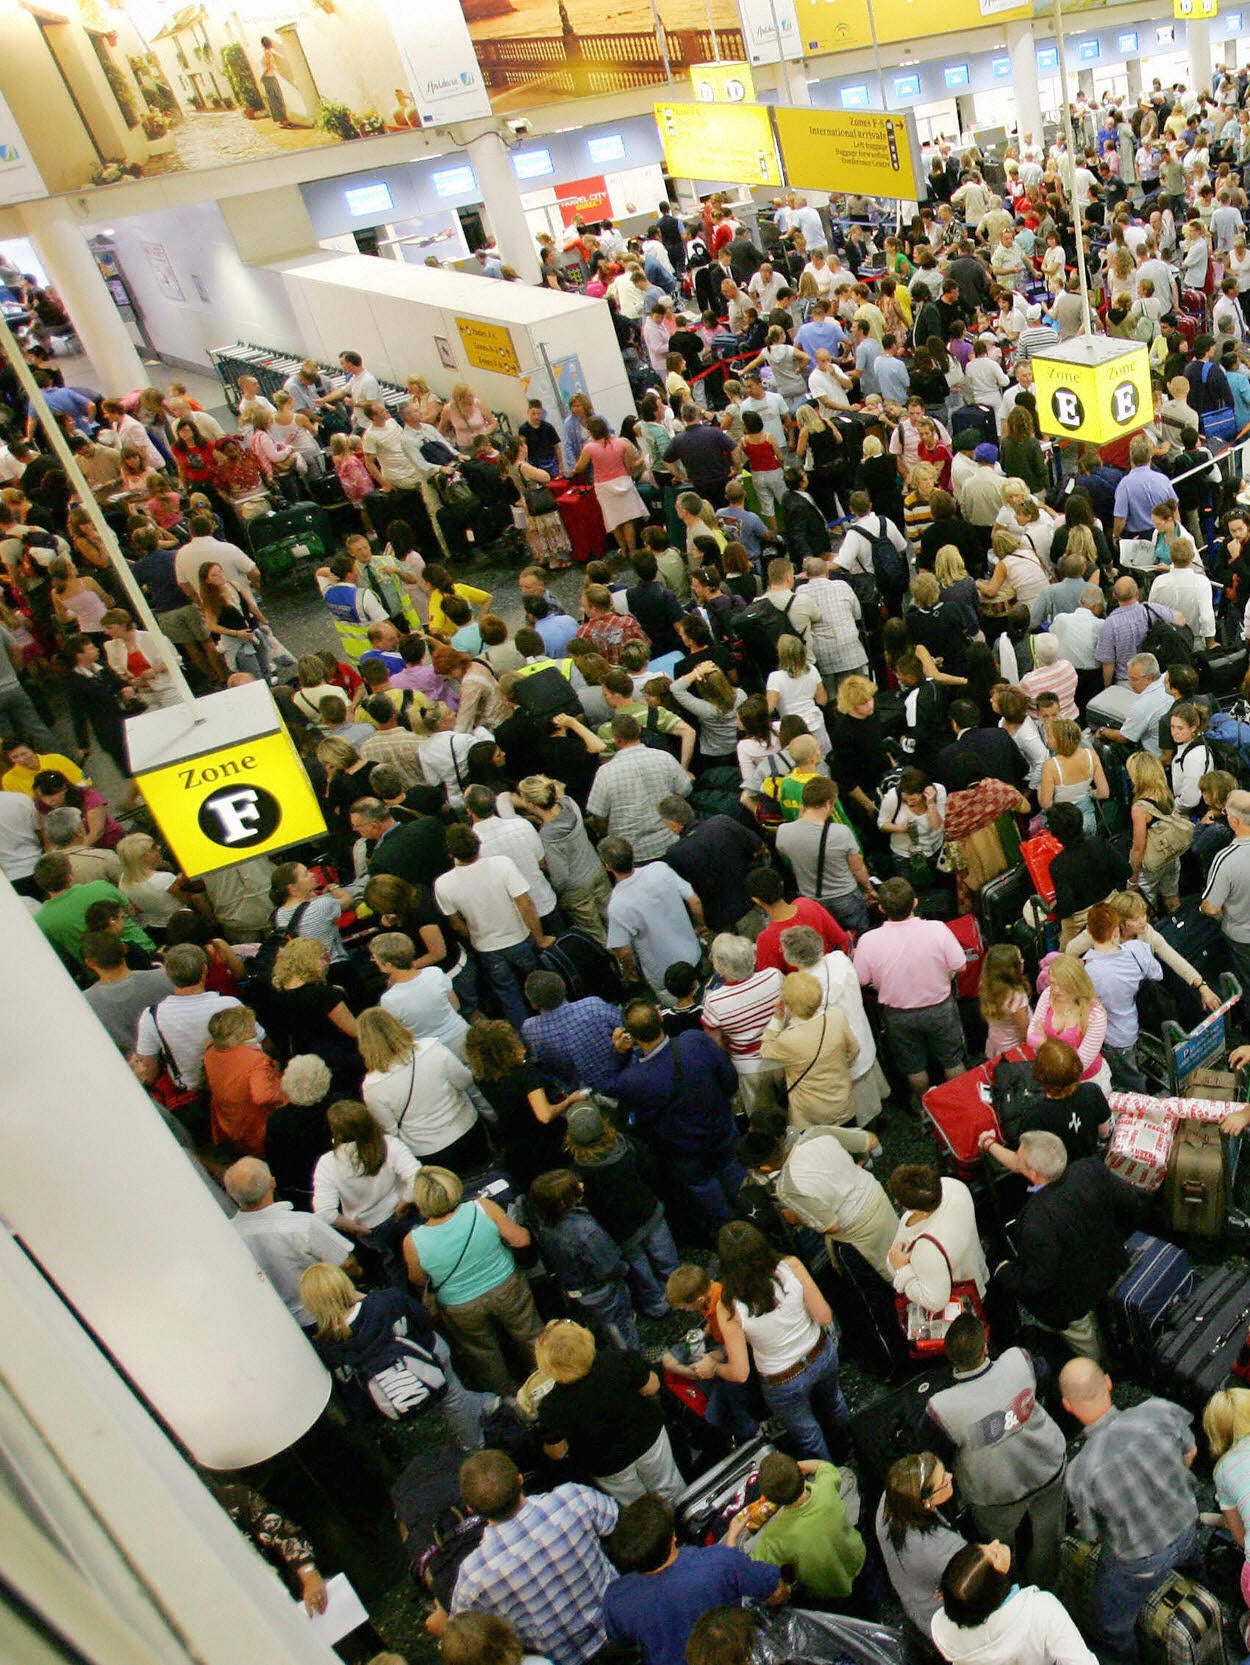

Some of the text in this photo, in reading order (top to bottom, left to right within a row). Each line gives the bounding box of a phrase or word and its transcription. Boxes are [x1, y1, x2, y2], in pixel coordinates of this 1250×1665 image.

[808, 126, 887, 141] International arrivals
[1048, 366, 1080, 383] Zone
[1107, 360, 1137, 381] Zone
[1055, 391, 1081, 427] E
[1114, 384, 1137, 423] E
[178, 754, 259, 791] Zone
[206, 789, 261, 845] F
